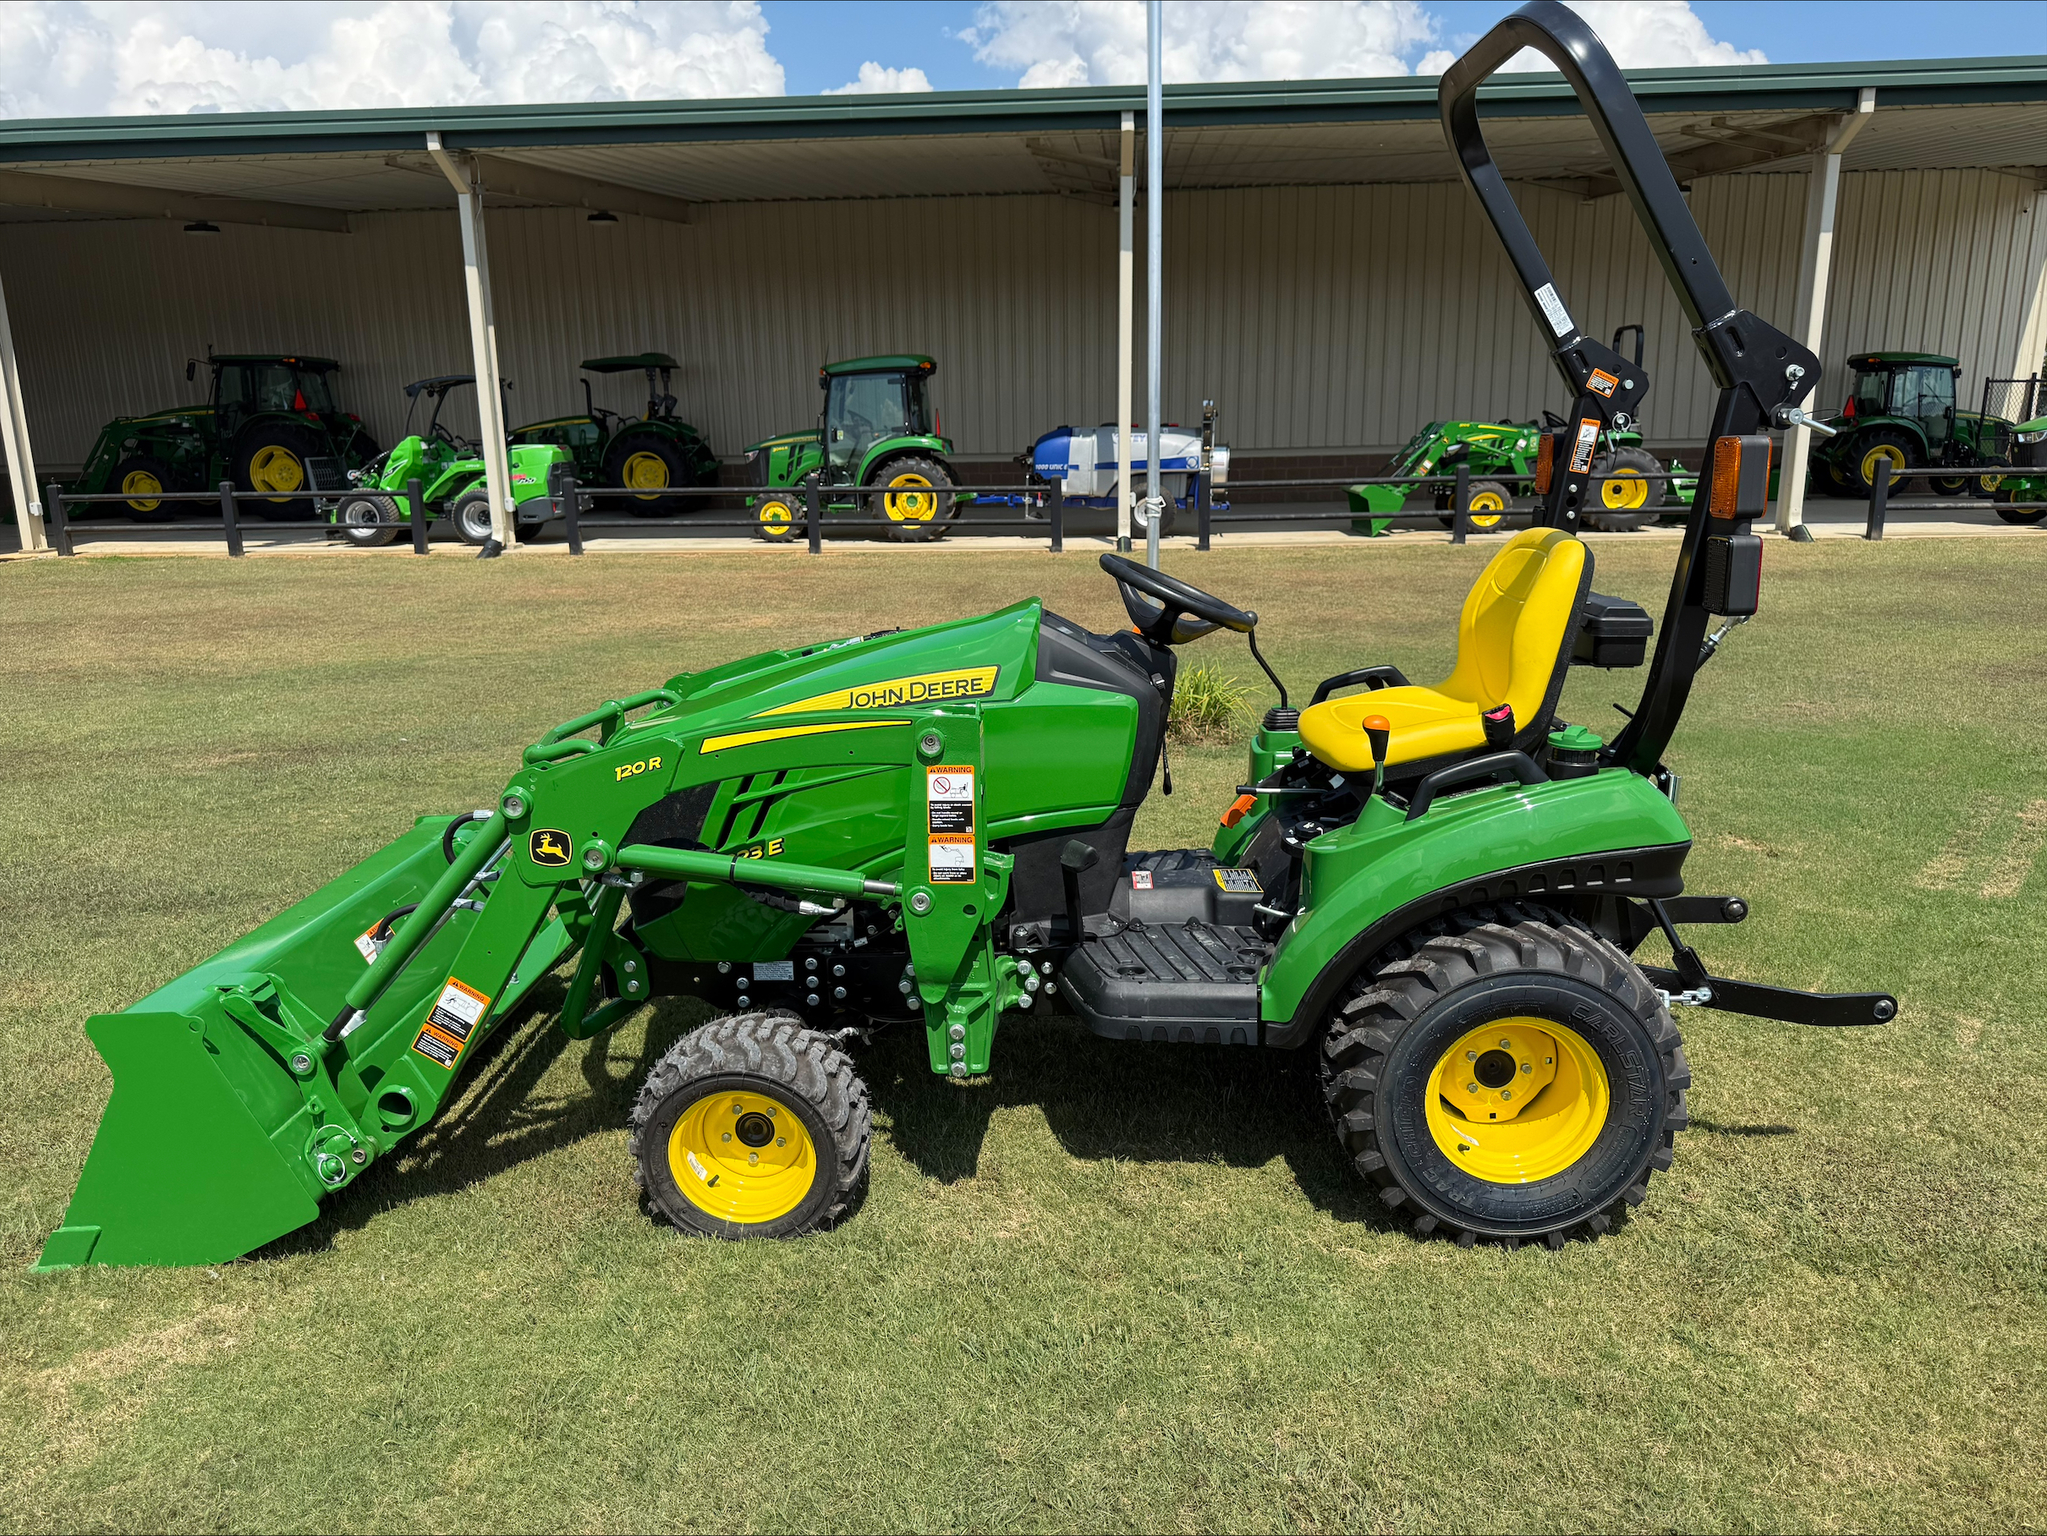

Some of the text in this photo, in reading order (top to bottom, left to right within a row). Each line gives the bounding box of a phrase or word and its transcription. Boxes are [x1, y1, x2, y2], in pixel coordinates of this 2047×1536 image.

[848, 677, 983, 708] JOHN DEERE
[614, 756, 662, 781] 120 R
[768, 838, 784, 856] E
[459, 985, 485, 1002] WARNING
[433, 1031, 459, 1048] WARNING
[1572, 1002, 1647, 1118] CARLSTAR
[1423, 1168, 1474, 1208] TRAC
